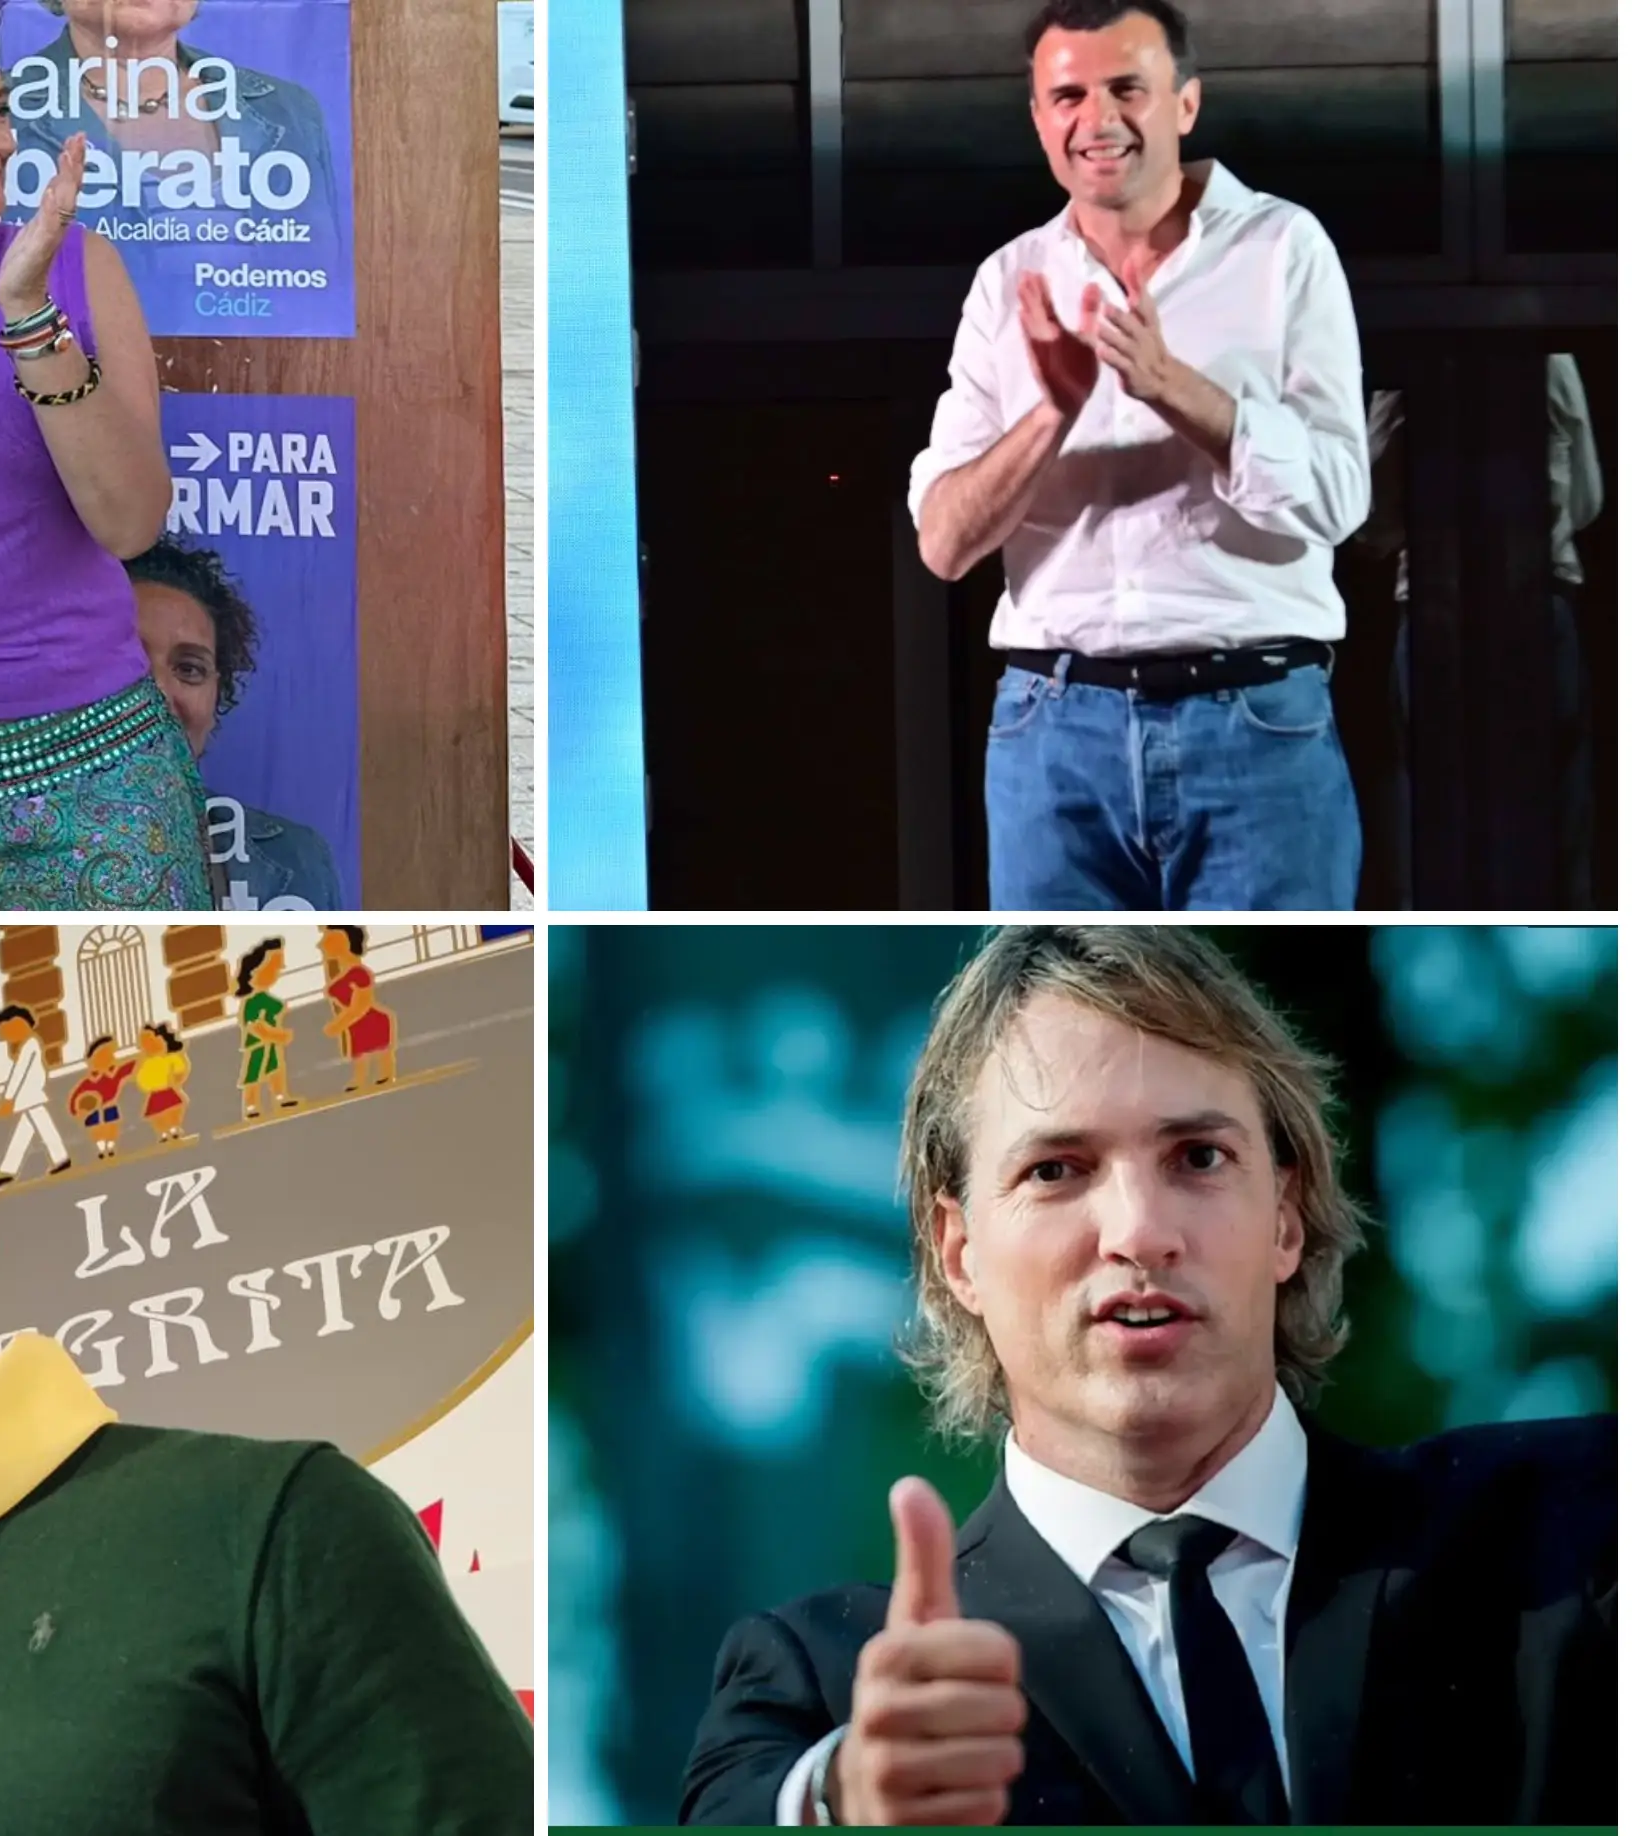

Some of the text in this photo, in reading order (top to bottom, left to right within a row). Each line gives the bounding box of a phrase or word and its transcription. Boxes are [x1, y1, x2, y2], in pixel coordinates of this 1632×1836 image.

[4, 128, 312, 211] berato
[95, 216, 311, 244] Alcaldía de Cádiz
[194, 262, 328, 289] Podemos
[194, 290, 273, 318] Cádiz
[228, 431, 338, 475] PARA
[166, 476, 336, 538] RMAR
[205, 796, 250, 863] a
[74, 1165, 229, 1279] LA
